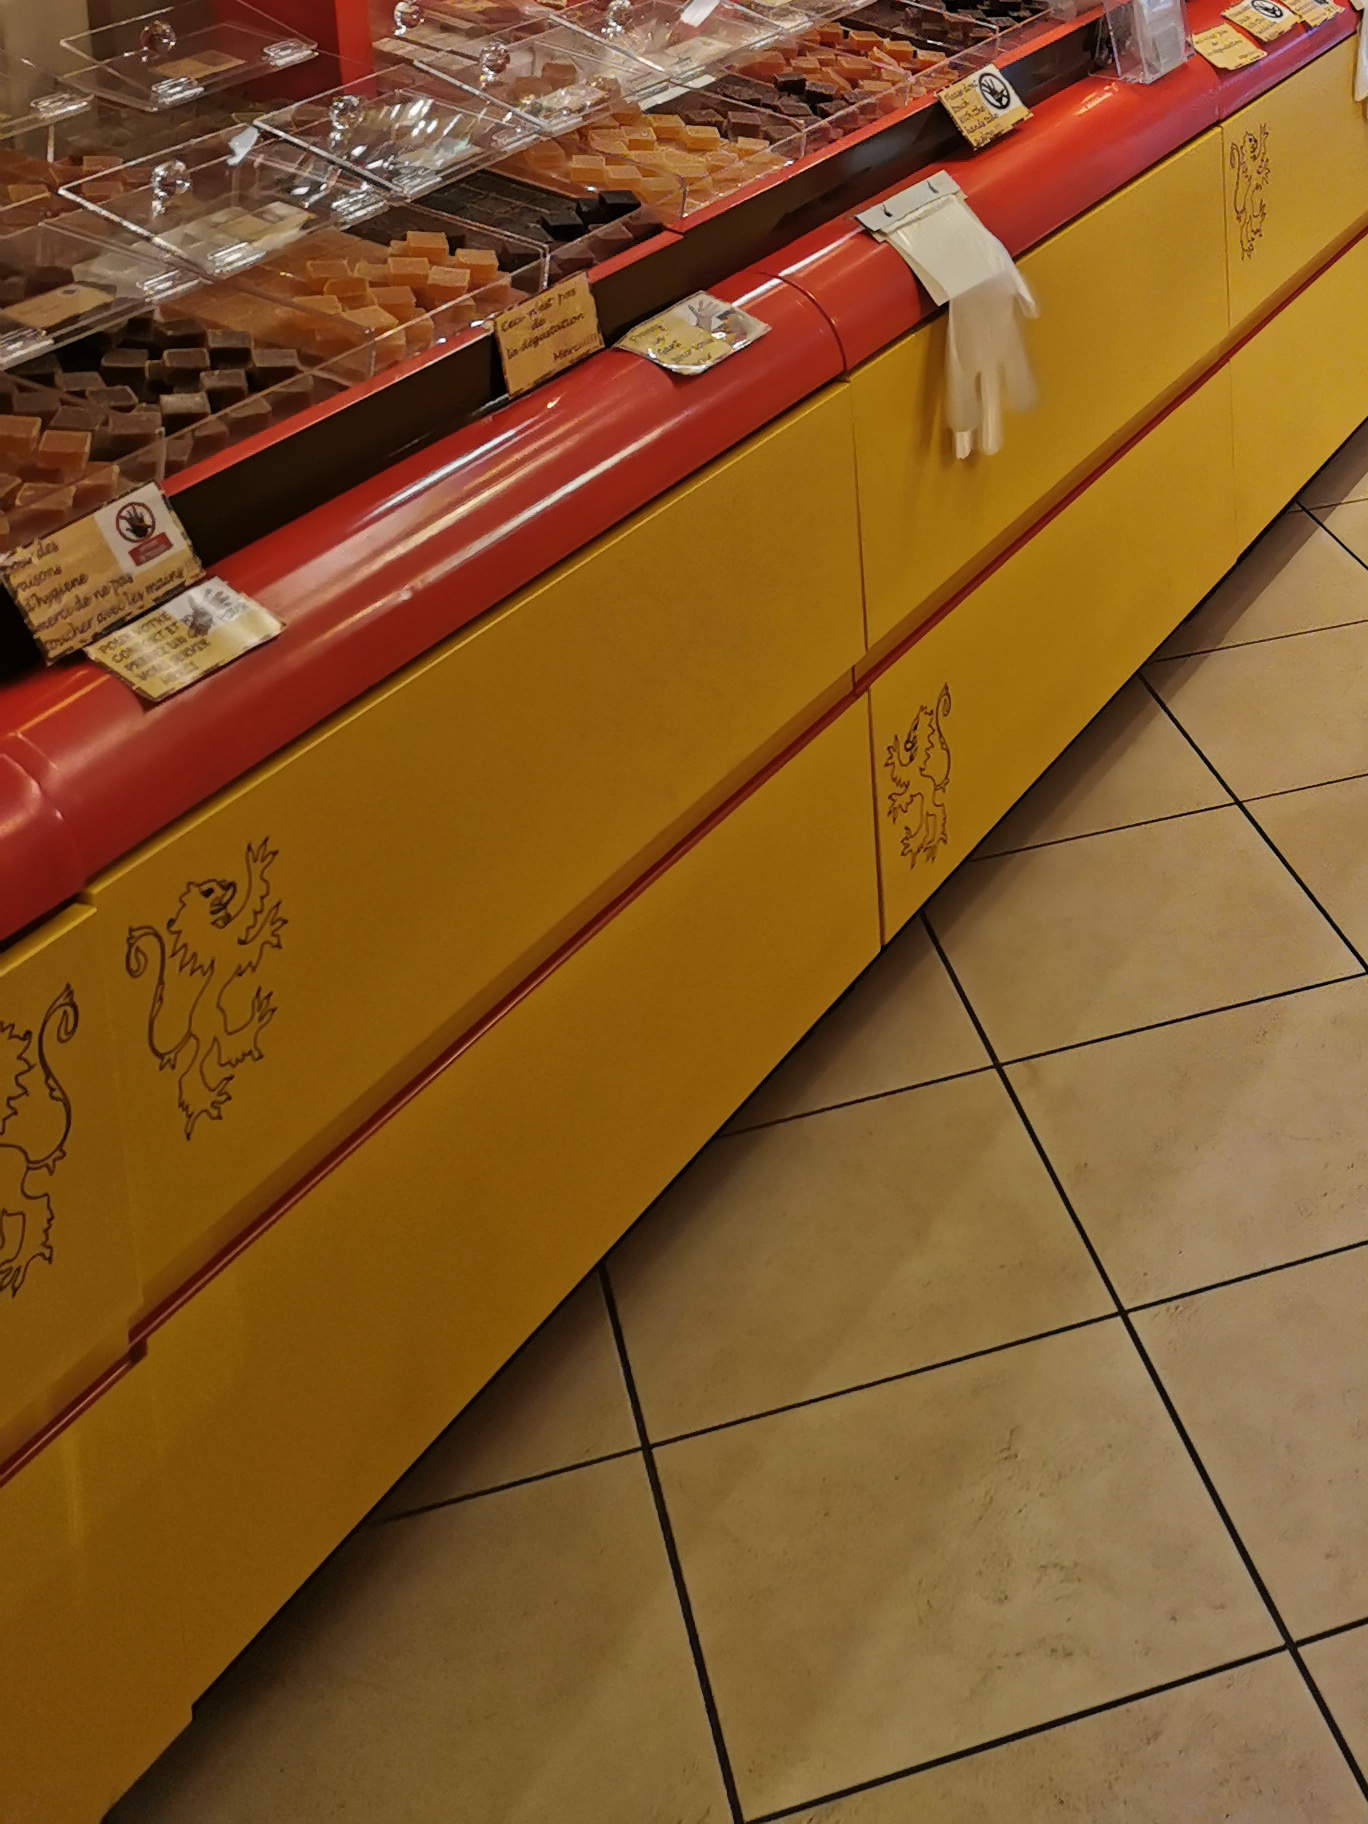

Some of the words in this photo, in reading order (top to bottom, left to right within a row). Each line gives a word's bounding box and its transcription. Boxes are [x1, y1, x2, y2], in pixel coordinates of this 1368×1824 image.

[557, 287, 576, 307] pas
[36, 541, 60, 560] des
[14, 565, 62, 591] raisons
[73, 593, 92, 612] de
[110, 575, 134, 600] pas
[124, 590, 144, 609] les
